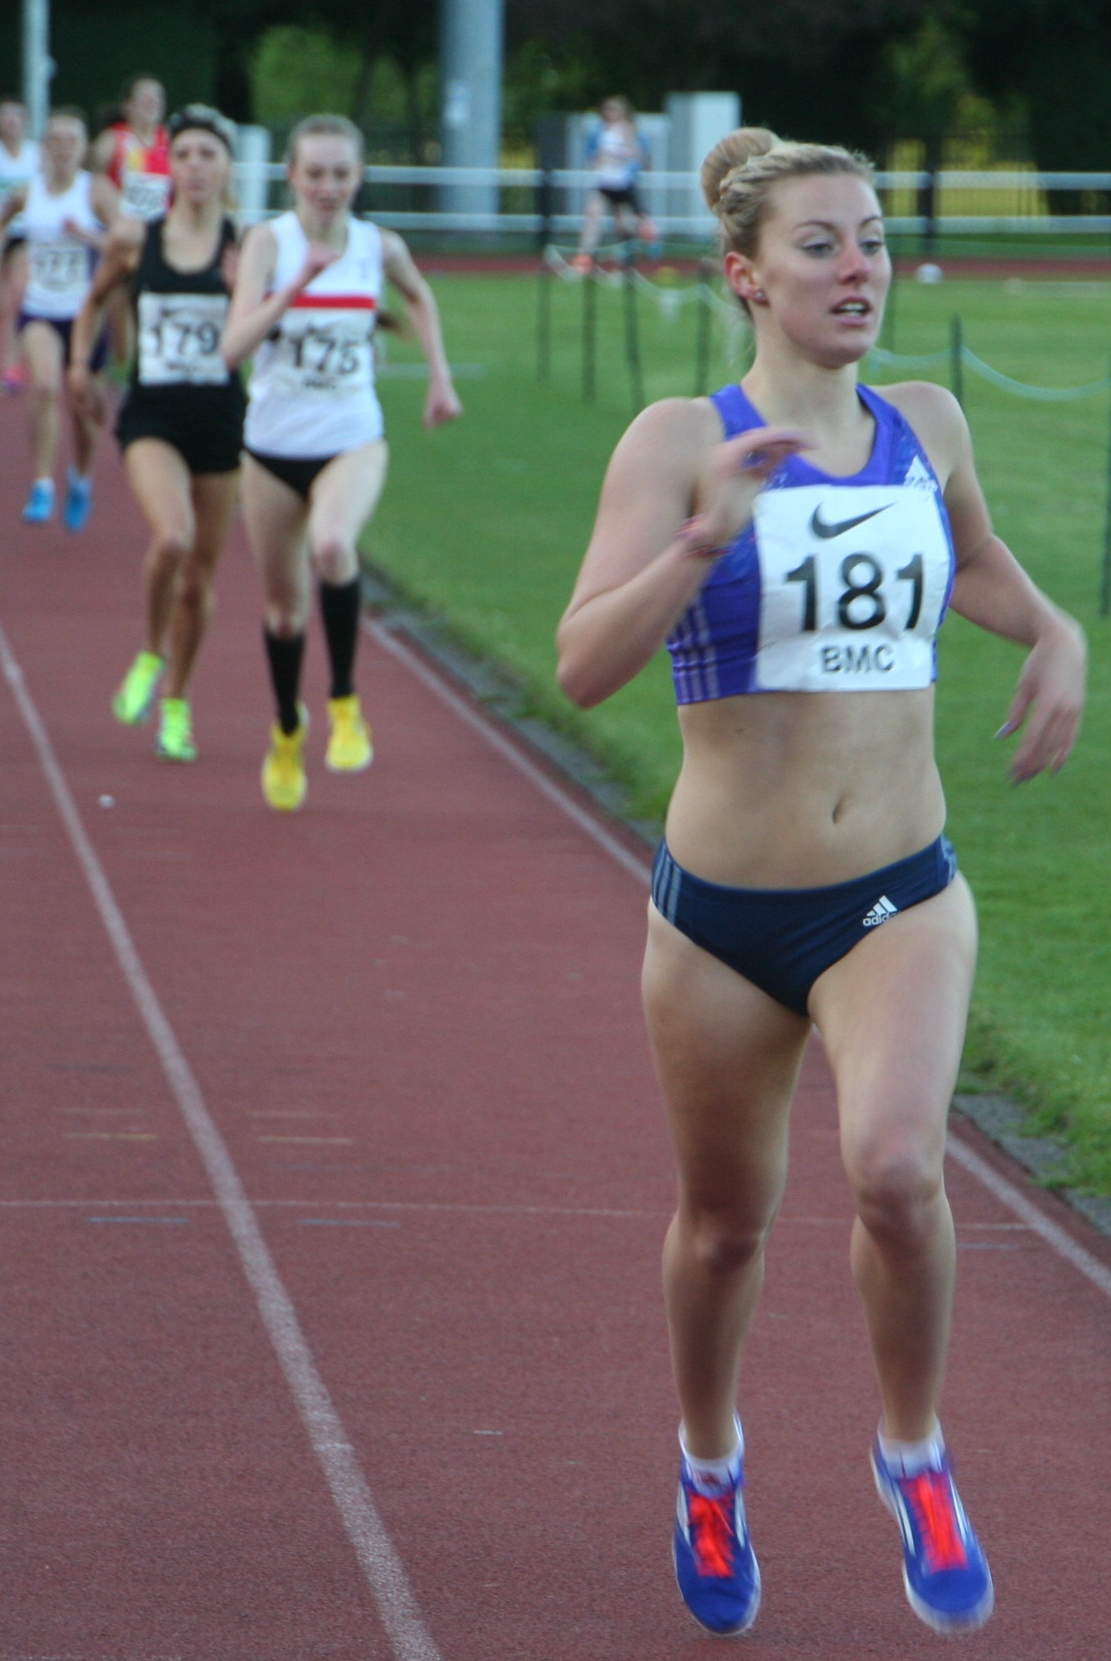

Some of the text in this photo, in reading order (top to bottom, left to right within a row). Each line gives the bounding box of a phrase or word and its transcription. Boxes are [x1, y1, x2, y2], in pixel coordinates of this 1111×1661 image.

[149, 321, 220, 354] 179
[289, 336, 358, 374] 175
[785, 553, 925, 632] 181
[821, 645, 895, 674] BMC
